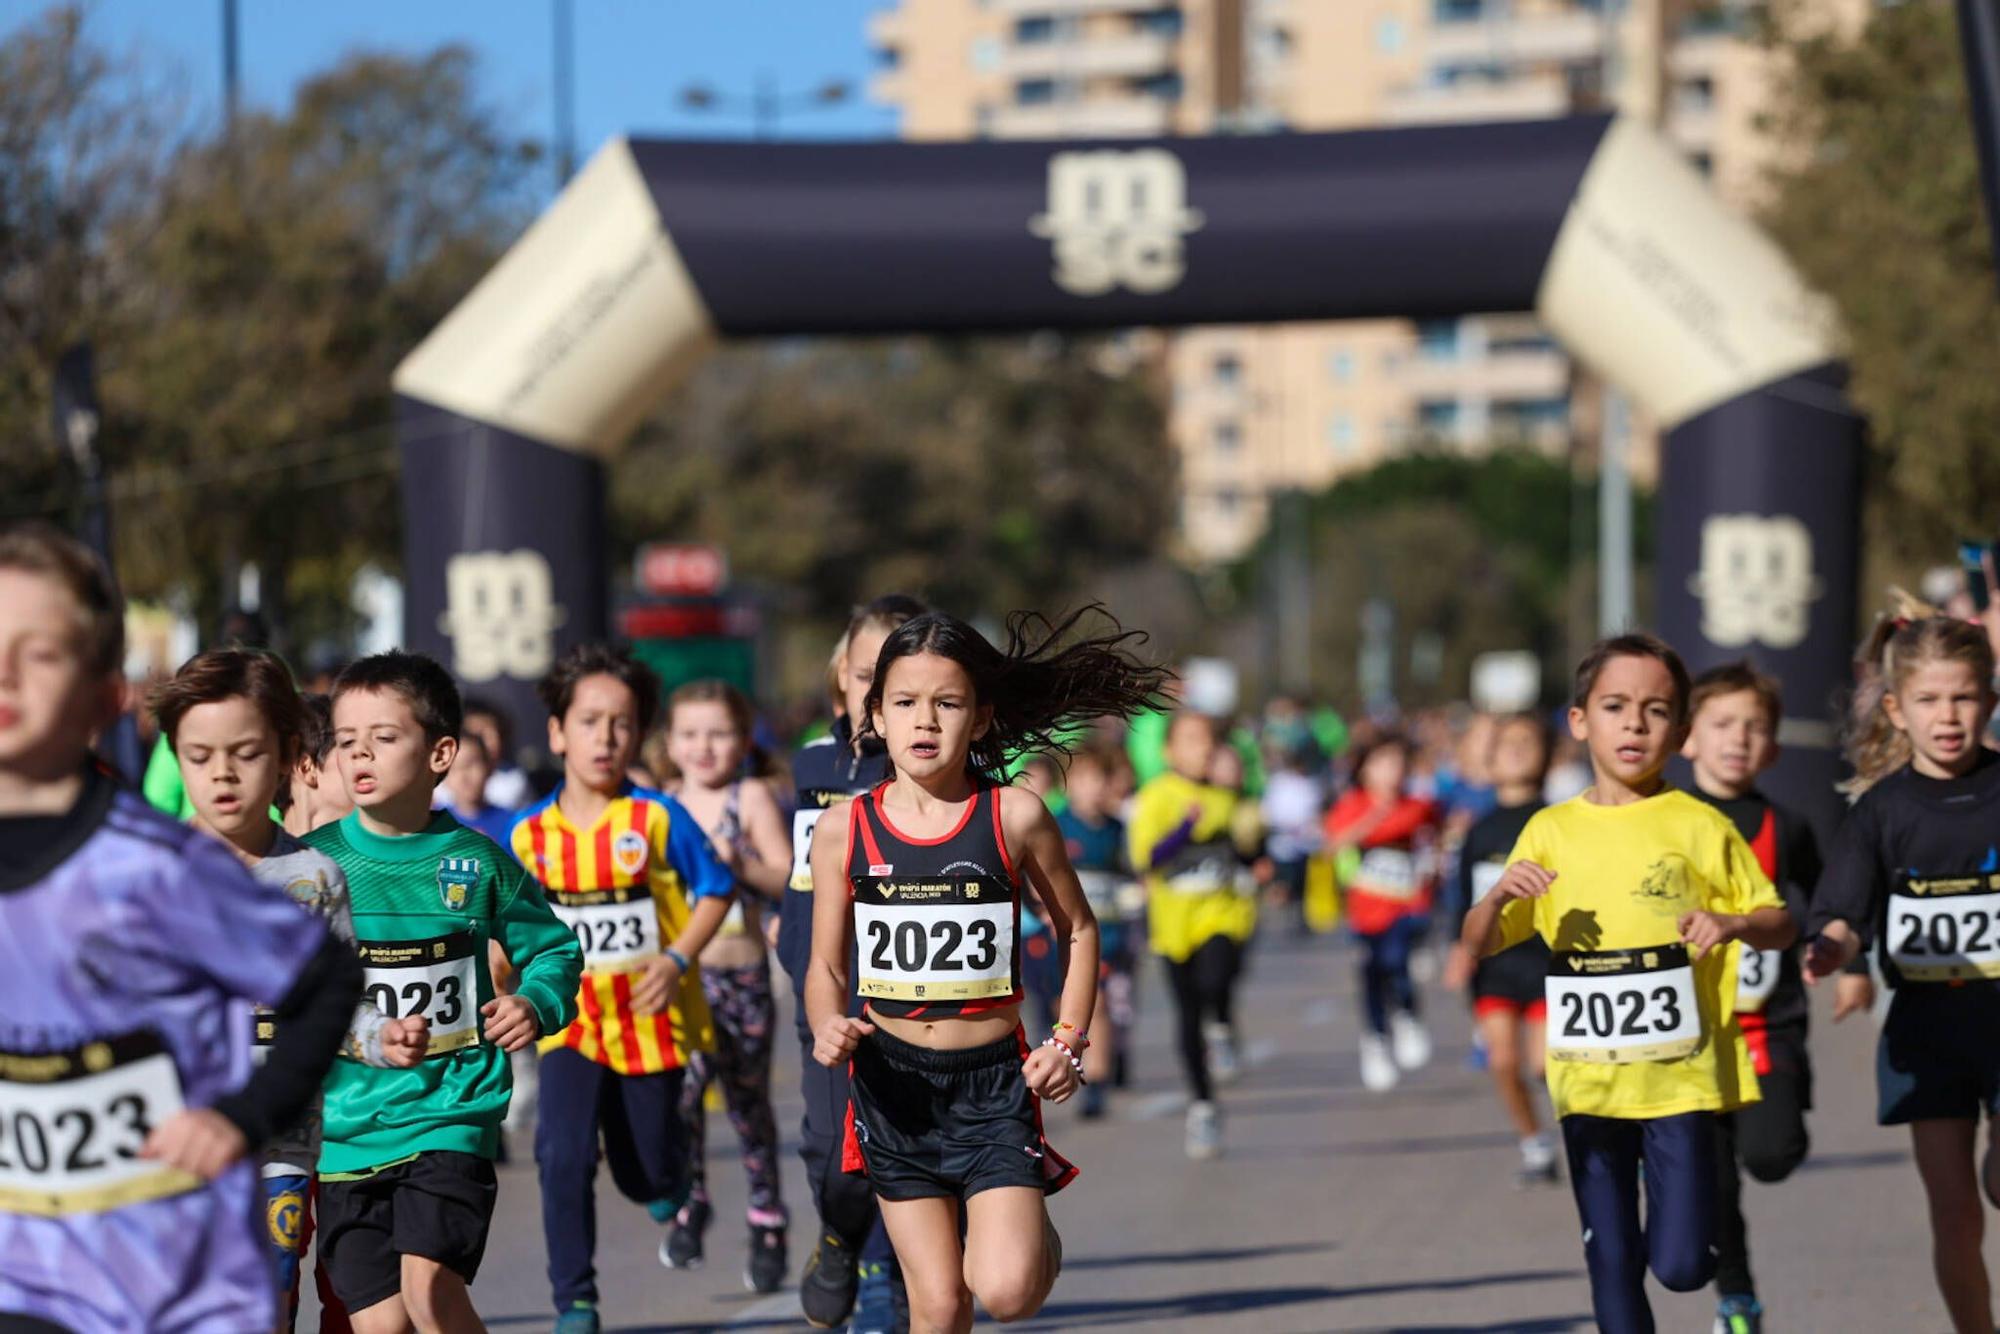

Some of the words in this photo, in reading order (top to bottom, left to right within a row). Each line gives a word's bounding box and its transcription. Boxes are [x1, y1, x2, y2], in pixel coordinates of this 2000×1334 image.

[867, 919, 997, 972] 2023
[1900, 911, 2000, 956] 202
[1561, 986, 1681, 1037] 2023
[0, 1093, 151, 1174] 023
